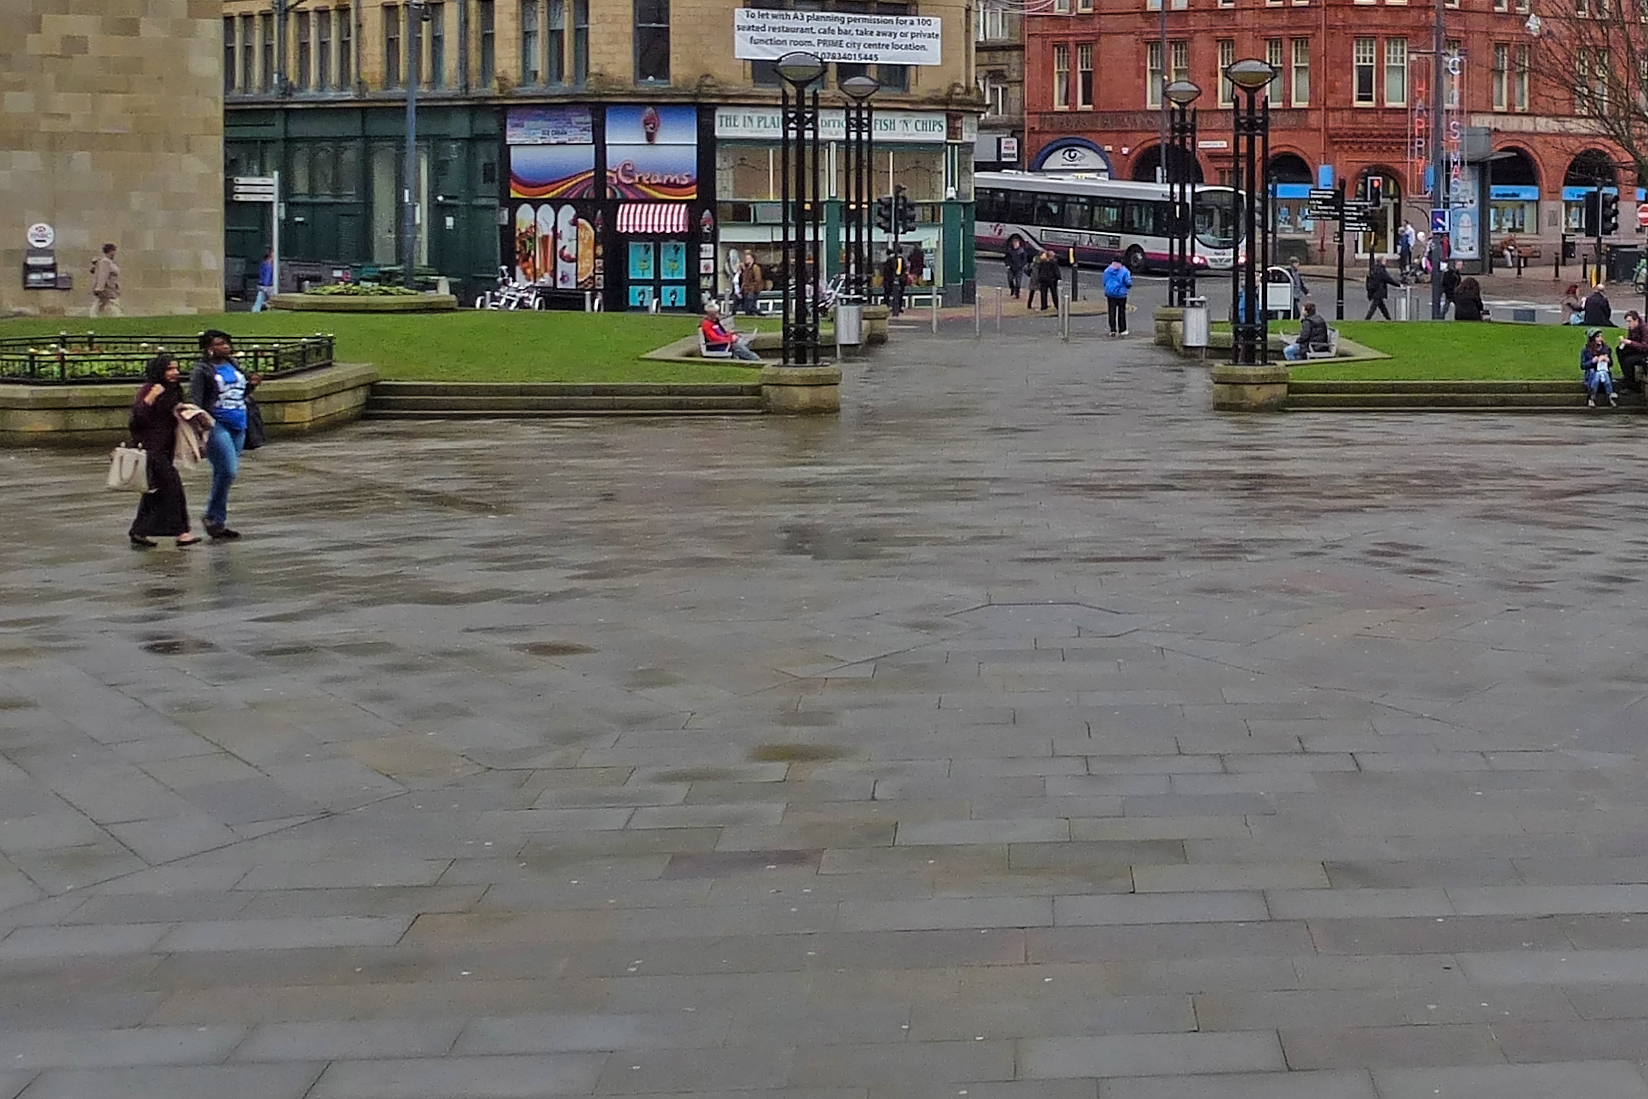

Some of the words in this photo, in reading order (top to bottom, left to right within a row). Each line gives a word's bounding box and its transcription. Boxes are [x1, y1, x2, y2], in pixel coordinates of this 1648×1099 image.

[745, 10, 756, 19] To
[758, 11, 769, 19] let
[771, 12, 791, 21] with
[793, 13, 804, 21] A3
[806, 14, 845, 25] planning
[847, 15, 894, 25] permission
[895, 17, 907, 26] for
[917, 19, 932, 27] 100
[737, 24, 766, 32] seated
[818, 27, 836, 35] cafe
[855, 29, 874, 37] take
[876, 31, 897, 39] away
[910, 31, 940, 40] private
[750, 36, 787, 46] function
[817, 39, 844, 48] PRIME
[846, 42, 861, 50] city
[892, 42, 928, 51] location.
[718, 115, 739, 128] THE
[743, 115, 755, 128] IN
[874, 118, 896, 132] FISH
[914, 119, 944, 132] CHIPS
[615, 160, 690, 185] Creams
